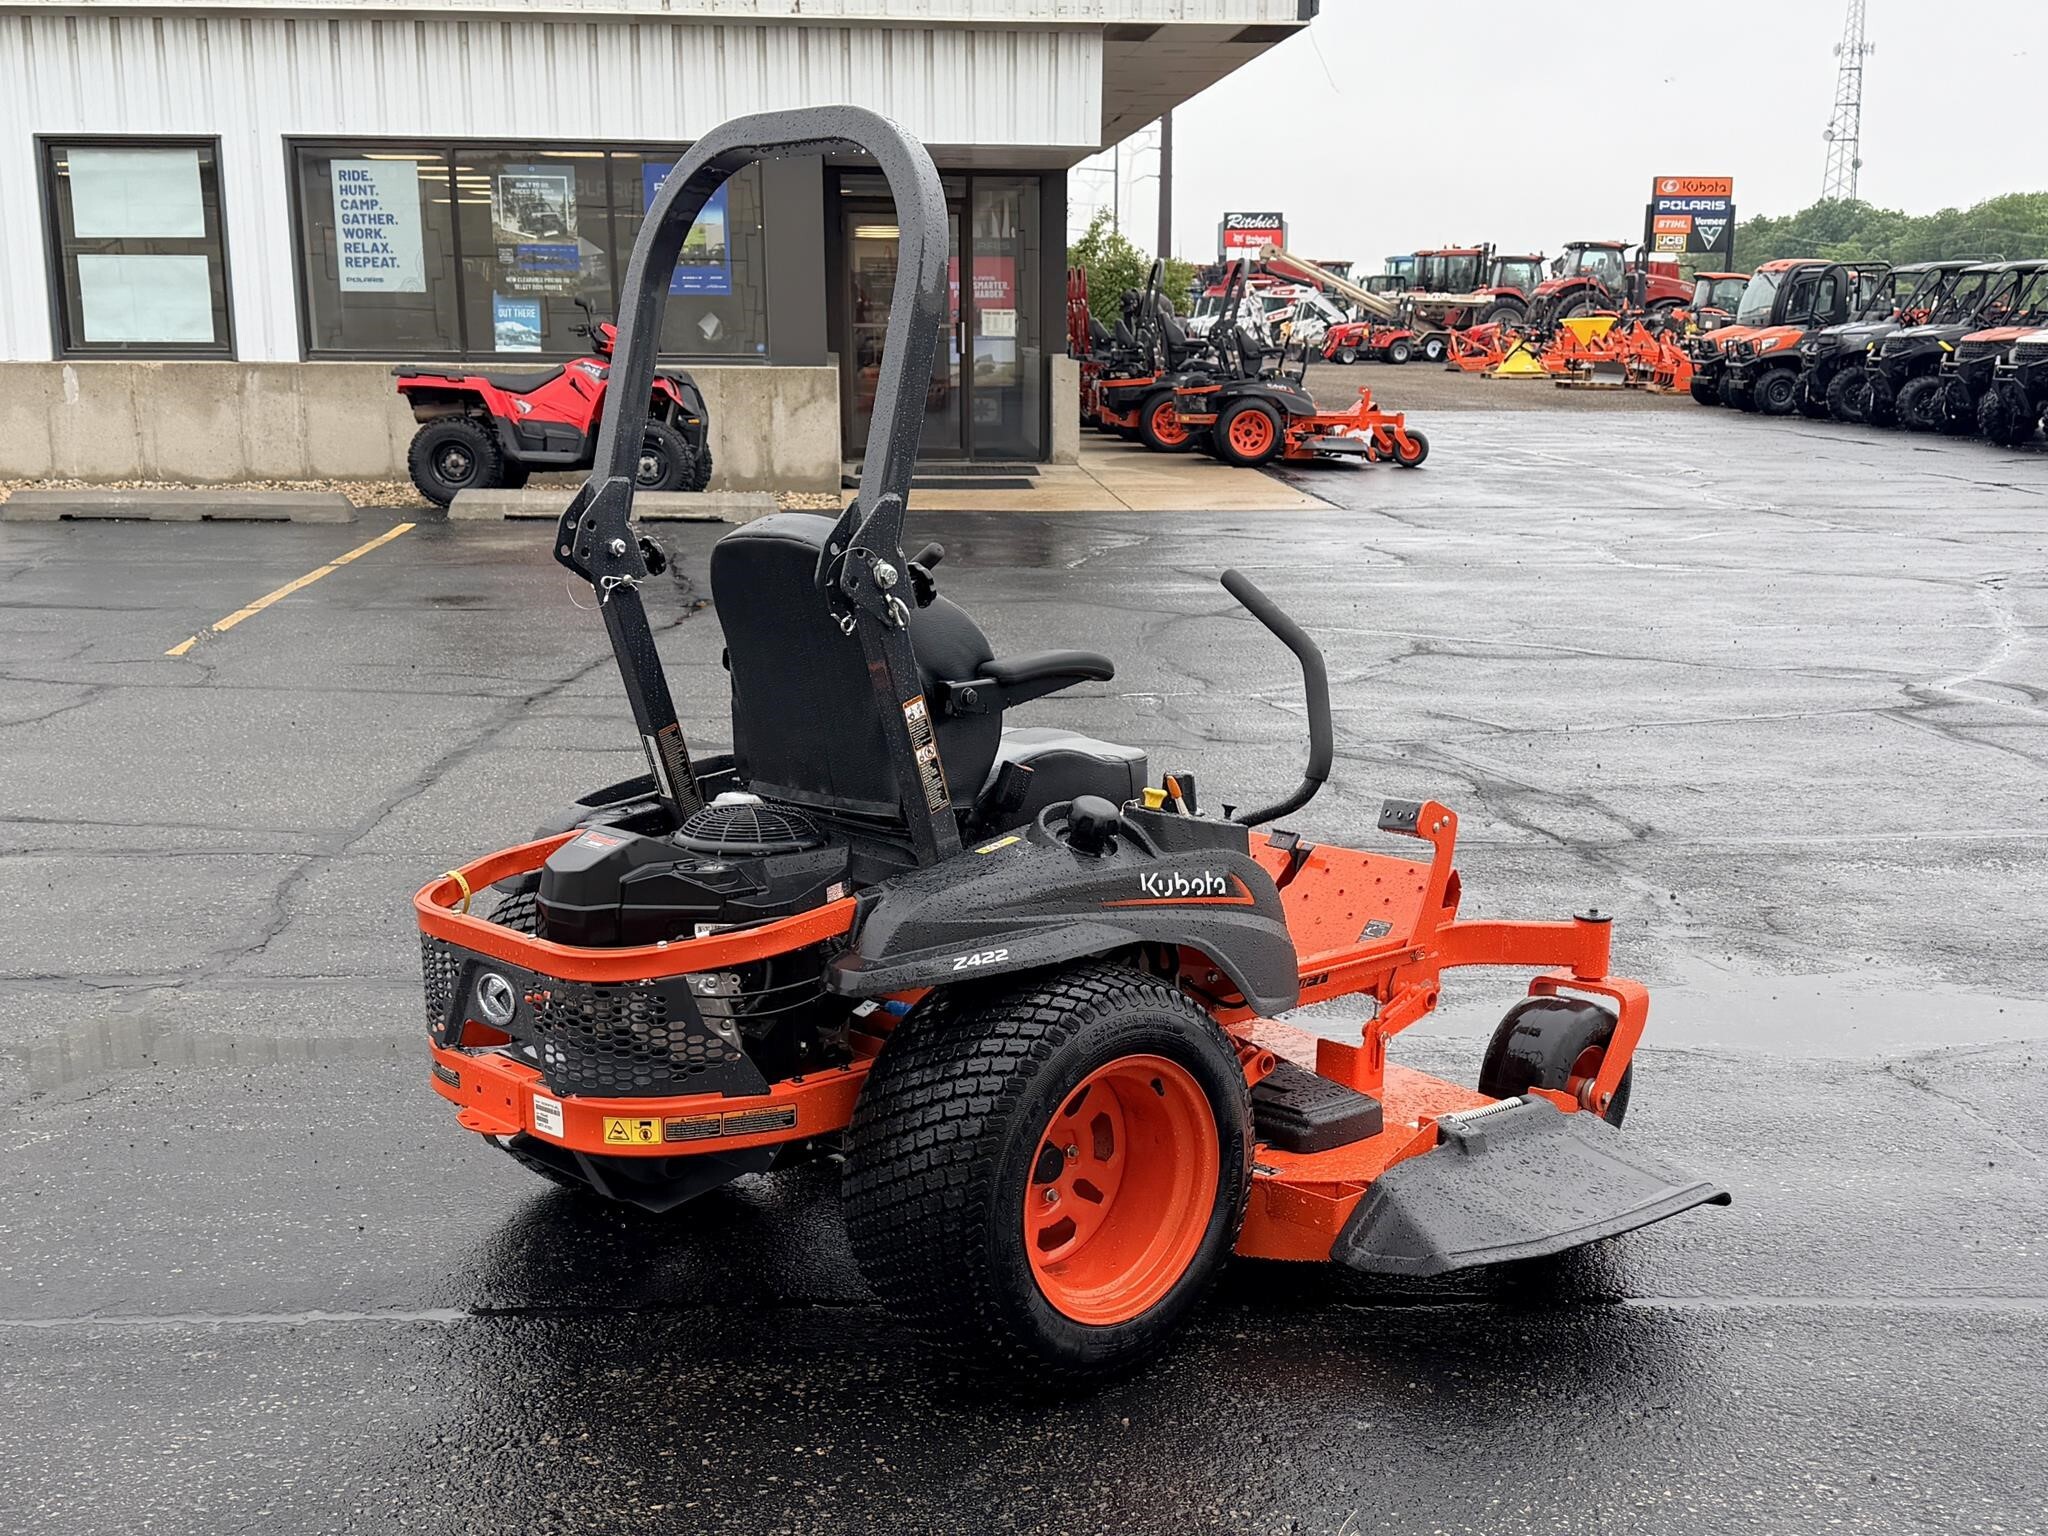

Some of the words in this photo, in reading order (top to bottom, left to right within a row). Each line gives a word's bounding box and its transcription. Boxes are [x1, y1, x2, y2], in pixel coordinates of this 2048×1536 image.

[338, 170, 373, 181] RIDE.
[339, 184, 379, 196] HUNT.
[1682, 181, 1727, 193] Kubota
[340, 199, 383, 210] CAMP.
[1659, 200, 1726, 211] POLARIS
[341, 213, 398, 225] GATHER.
[1227, 214, 1280, 229] Ritchie's
[1657, 219, 1688, 228] STIHL
[1694, 216, 1727, 226] Vermeer
[342, 228, 387, 239] WORK.
[1659, 236, 1684, 245] JCB
[344, 242, 394, 254] RELAX.
[345, 257, 400, 268] REPEAT.
[973, 281, 1010, 290] SMARTER.
[497, 308, 512, 318] OUT
[514, 308, 536, 318] THERE
[1140, 870, 1226, 897] Kubota
[952, 949, 1009, 971] Z422
